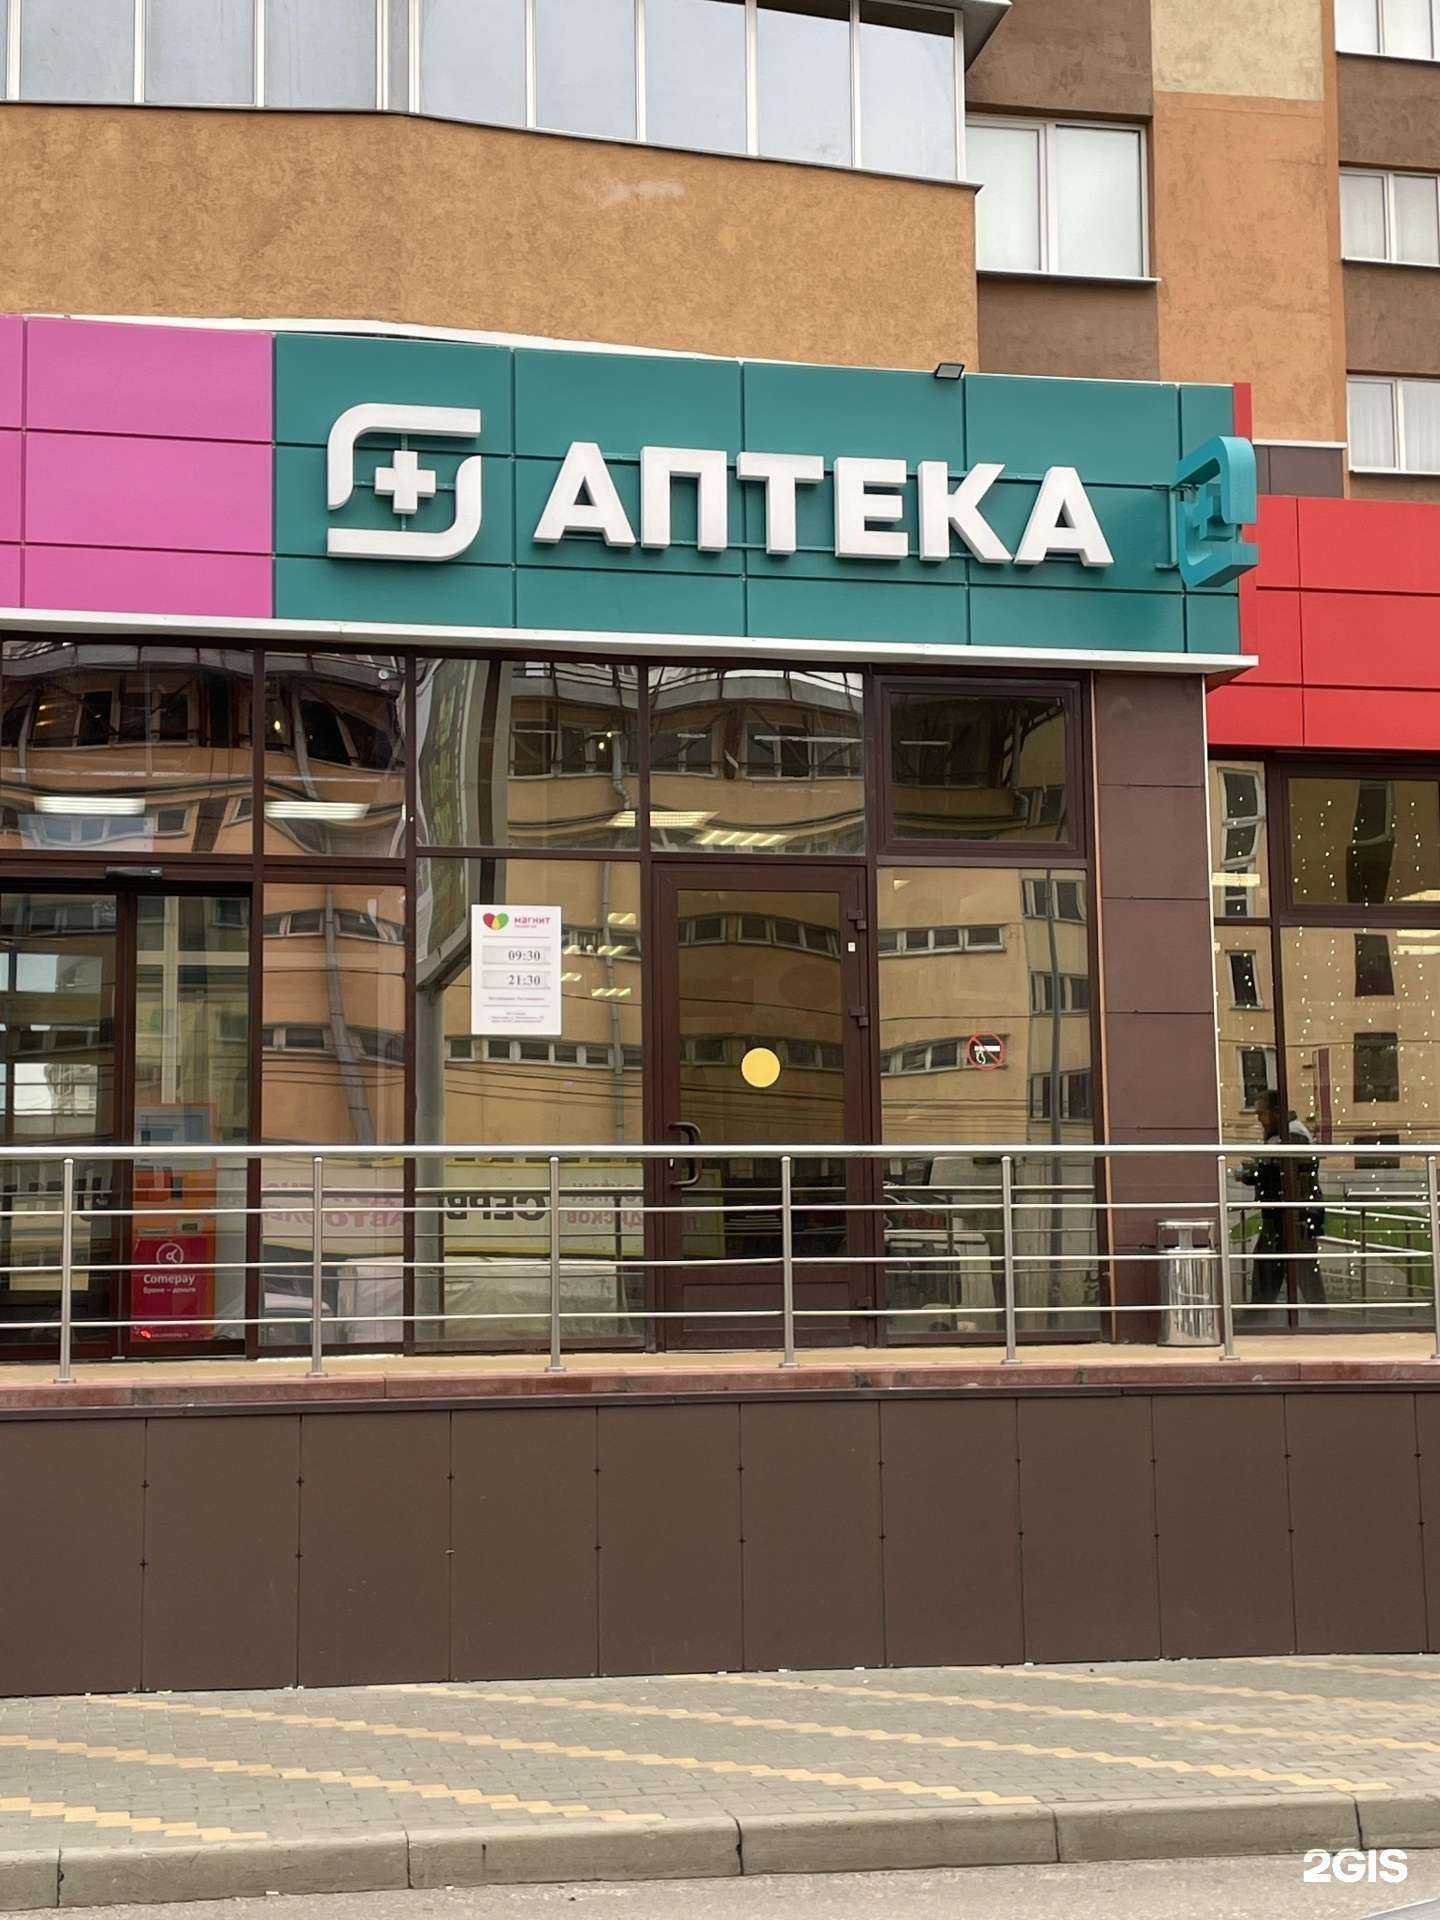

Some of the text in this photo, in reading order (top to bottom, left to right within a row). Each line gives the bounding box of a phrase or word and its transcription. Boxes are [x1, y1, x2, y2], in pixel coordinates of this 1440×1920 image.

[533, 441, 1114, 567] АПТЕКА
[508, 950, 541, 961] 09:30
[508, 974, 541, 985] 21:30
[143, 1273, 196, 1286] Comepay
